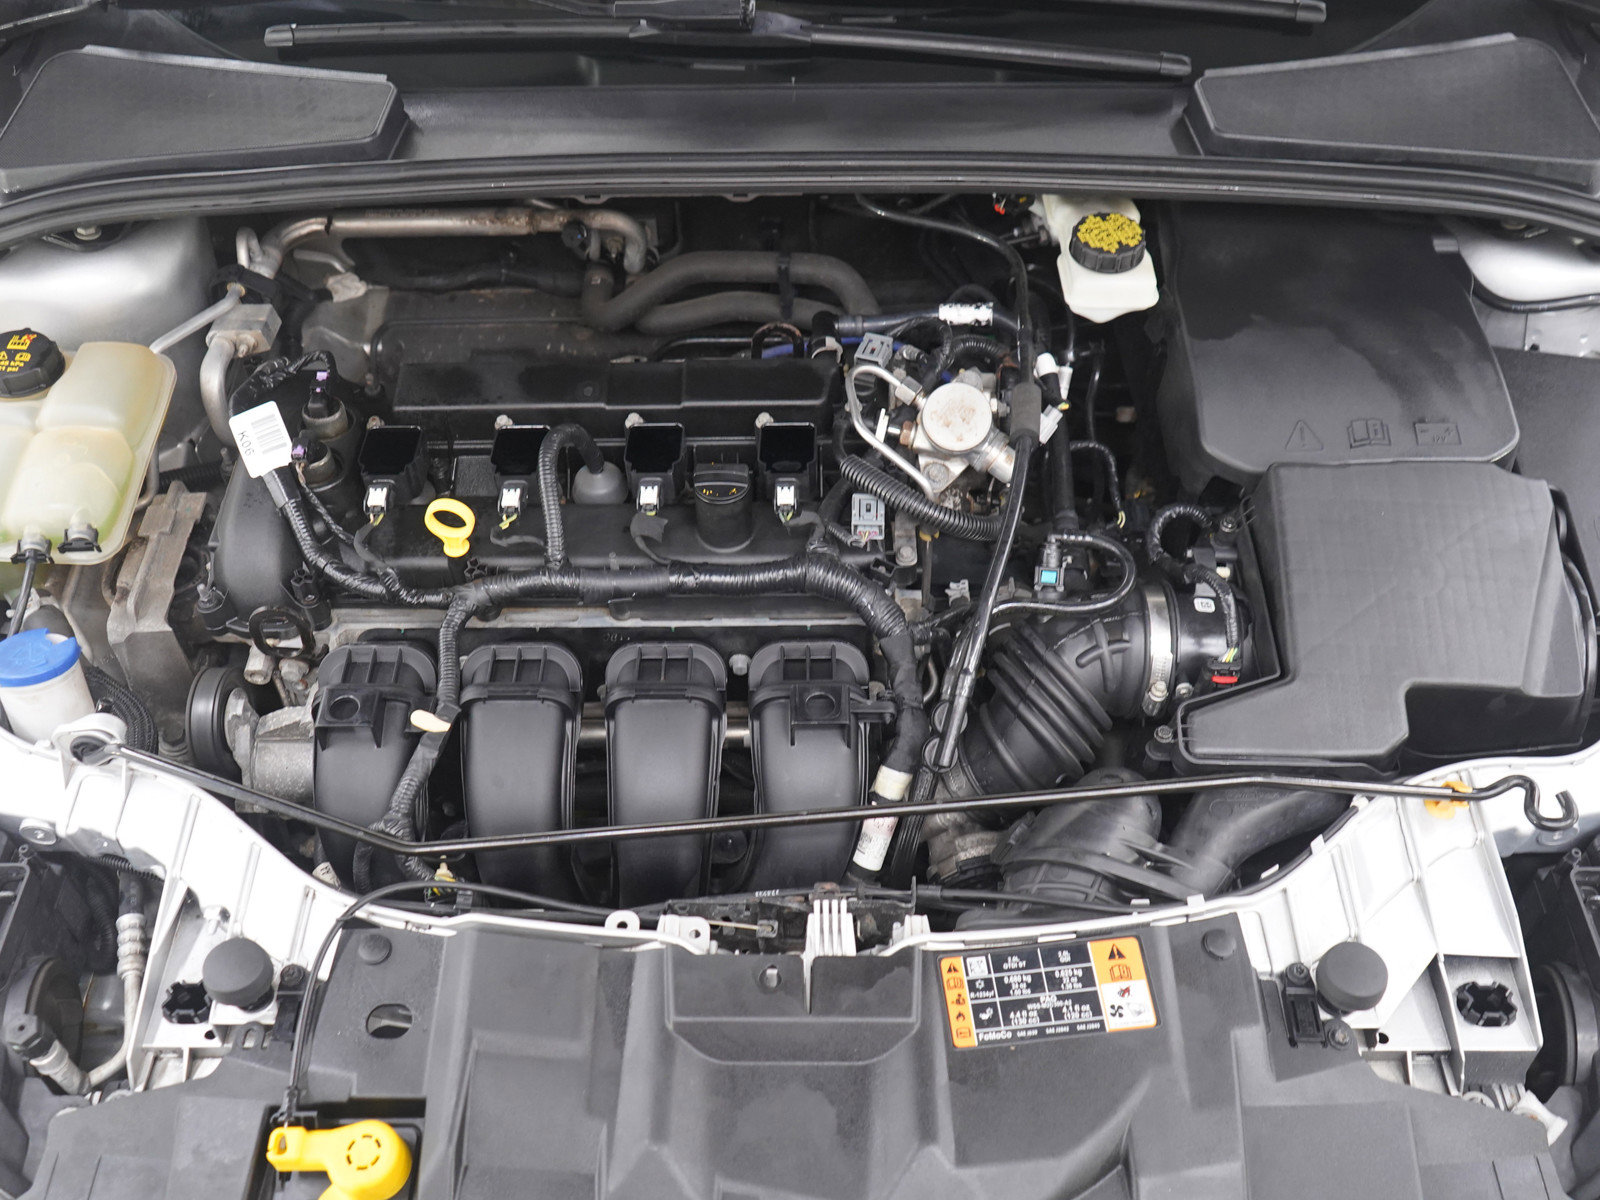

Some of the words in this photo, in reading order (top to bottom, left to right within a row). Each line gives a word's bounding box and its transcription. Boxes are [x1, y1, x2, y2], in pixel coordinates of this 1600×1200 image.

[1074, 968, 1083, 977] kg
[1023, 974, 1032, 983] kg
[970, 990, 994, 999] R-1234yf
[979, 1030, 1012, 1041] FoMoCo
